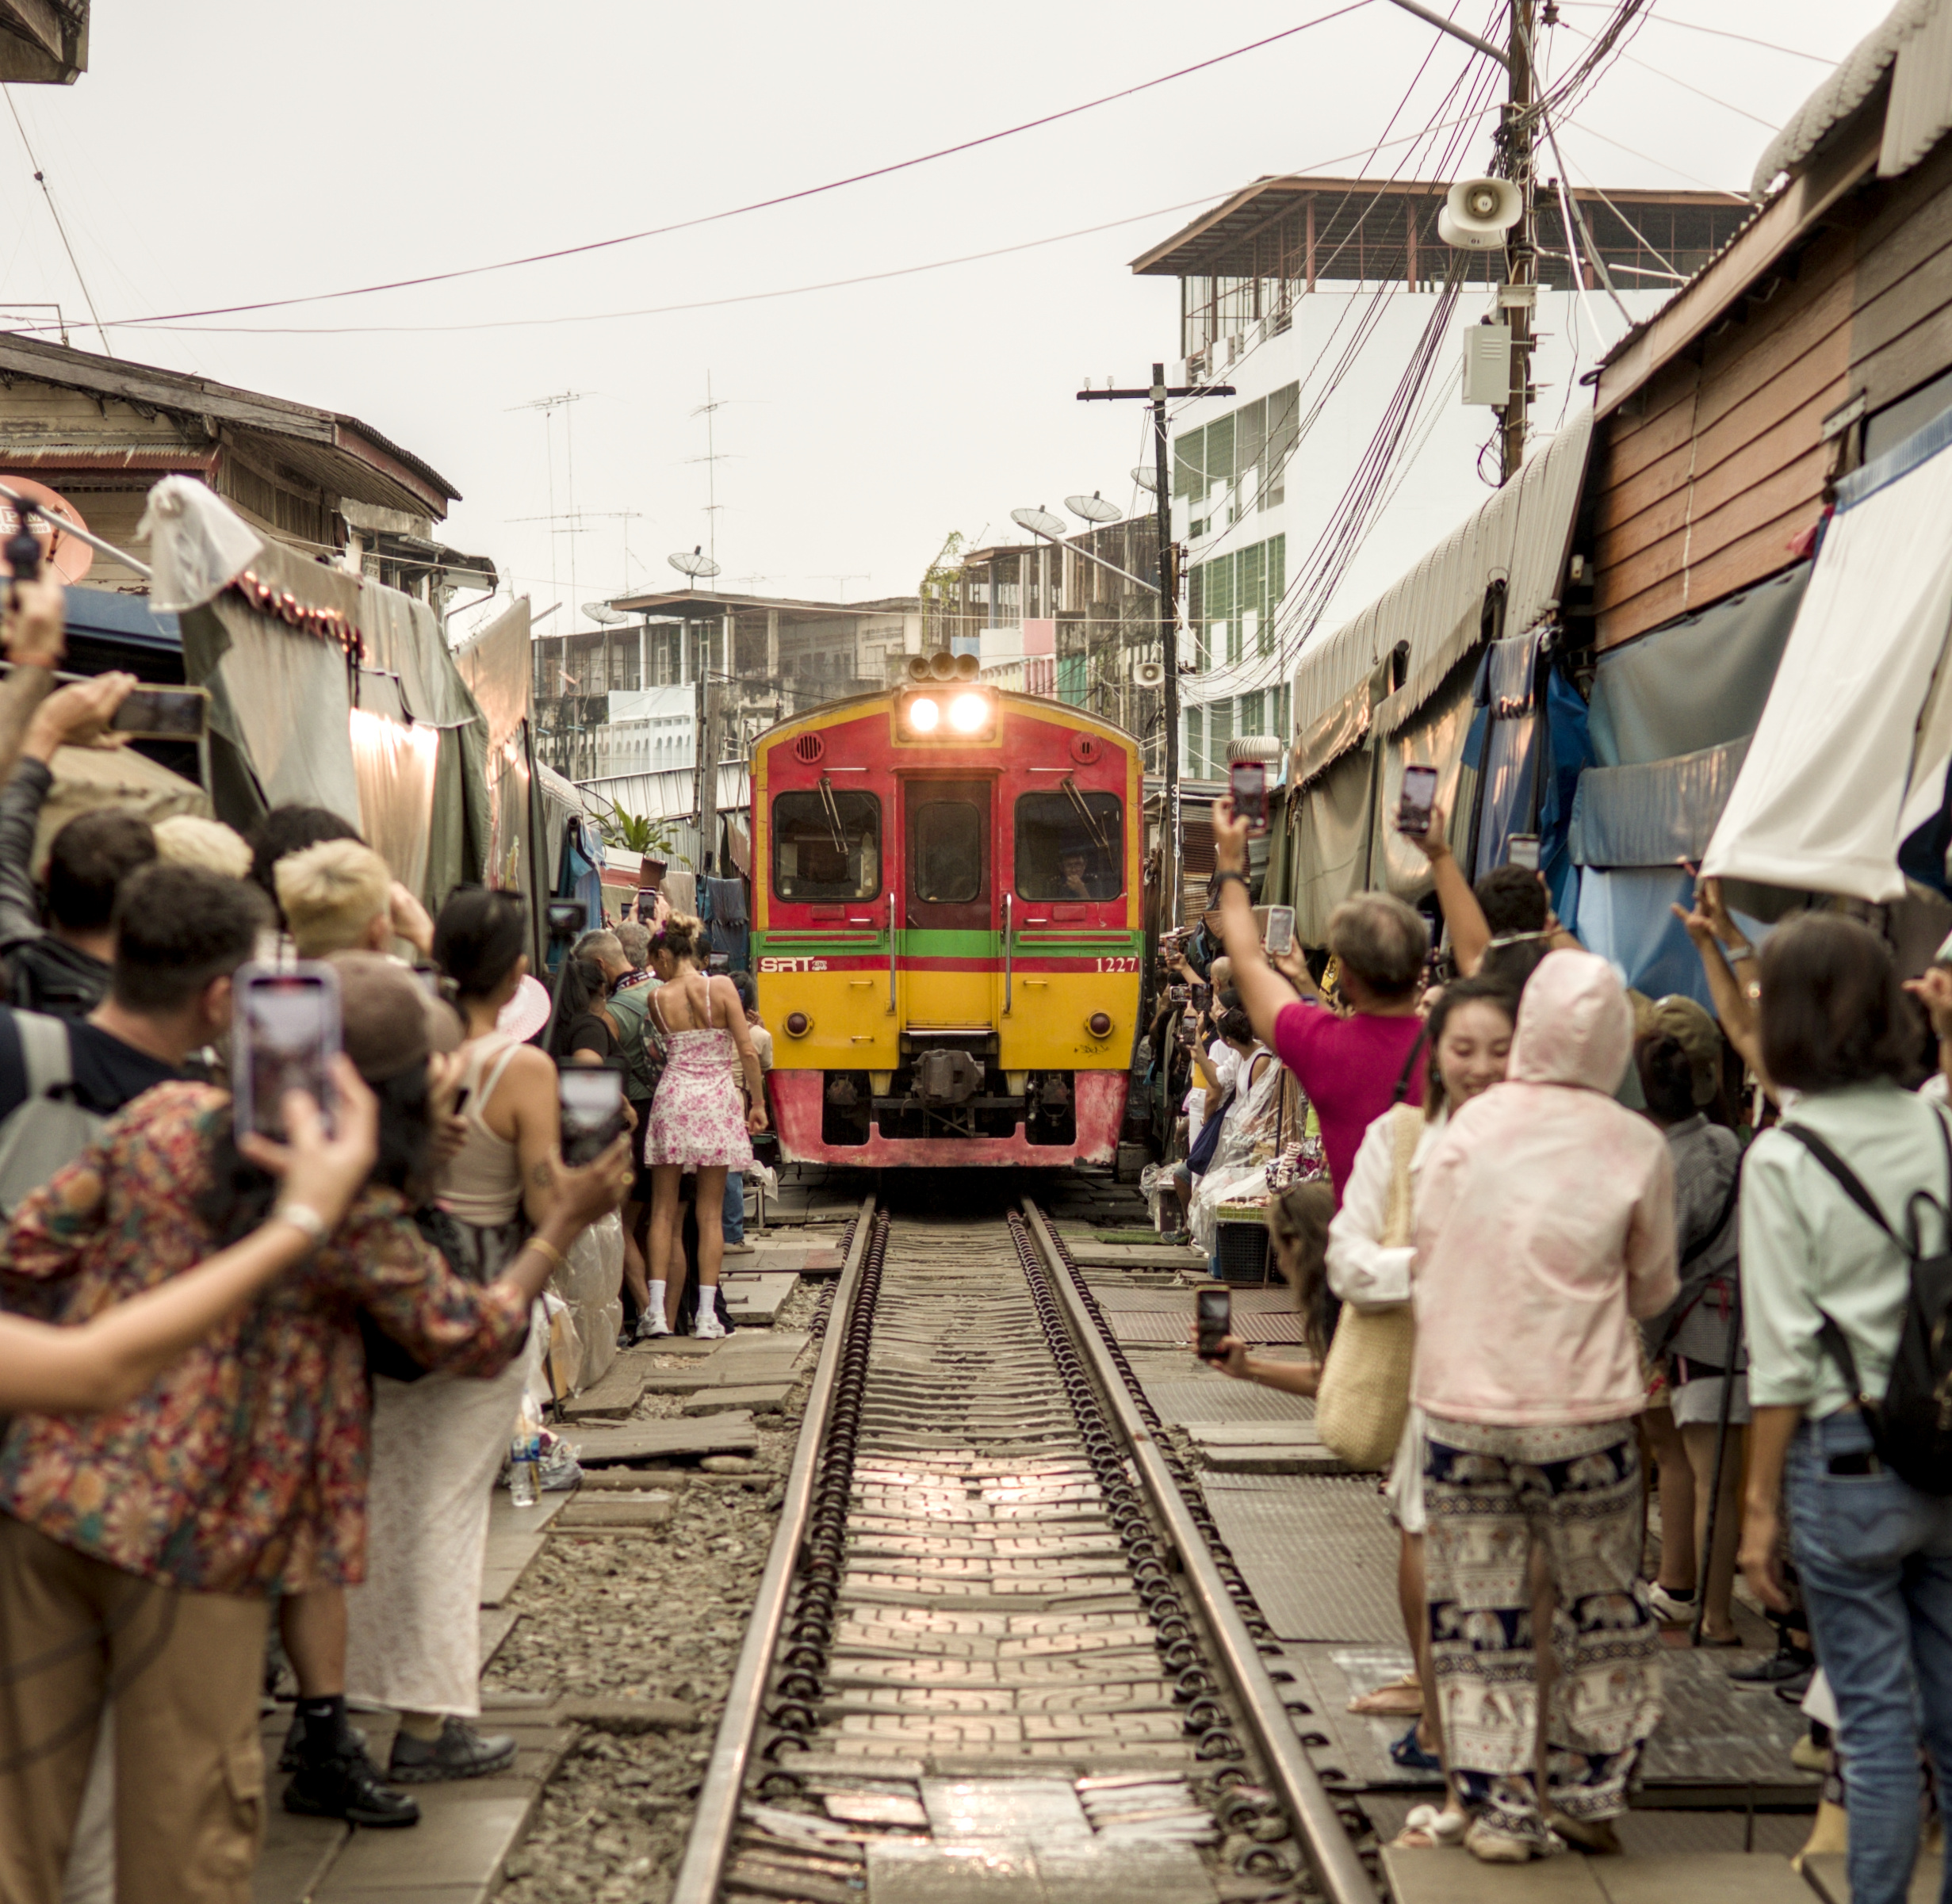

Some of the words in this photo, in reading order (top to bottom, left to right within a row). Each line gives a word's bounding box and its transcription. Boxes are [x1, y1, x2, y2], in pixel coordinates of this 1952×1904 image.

[3, 511, 43, 522] PM
[761, 957, 814, 972] SRT
[1096, 958, 1136, 973] 1227
